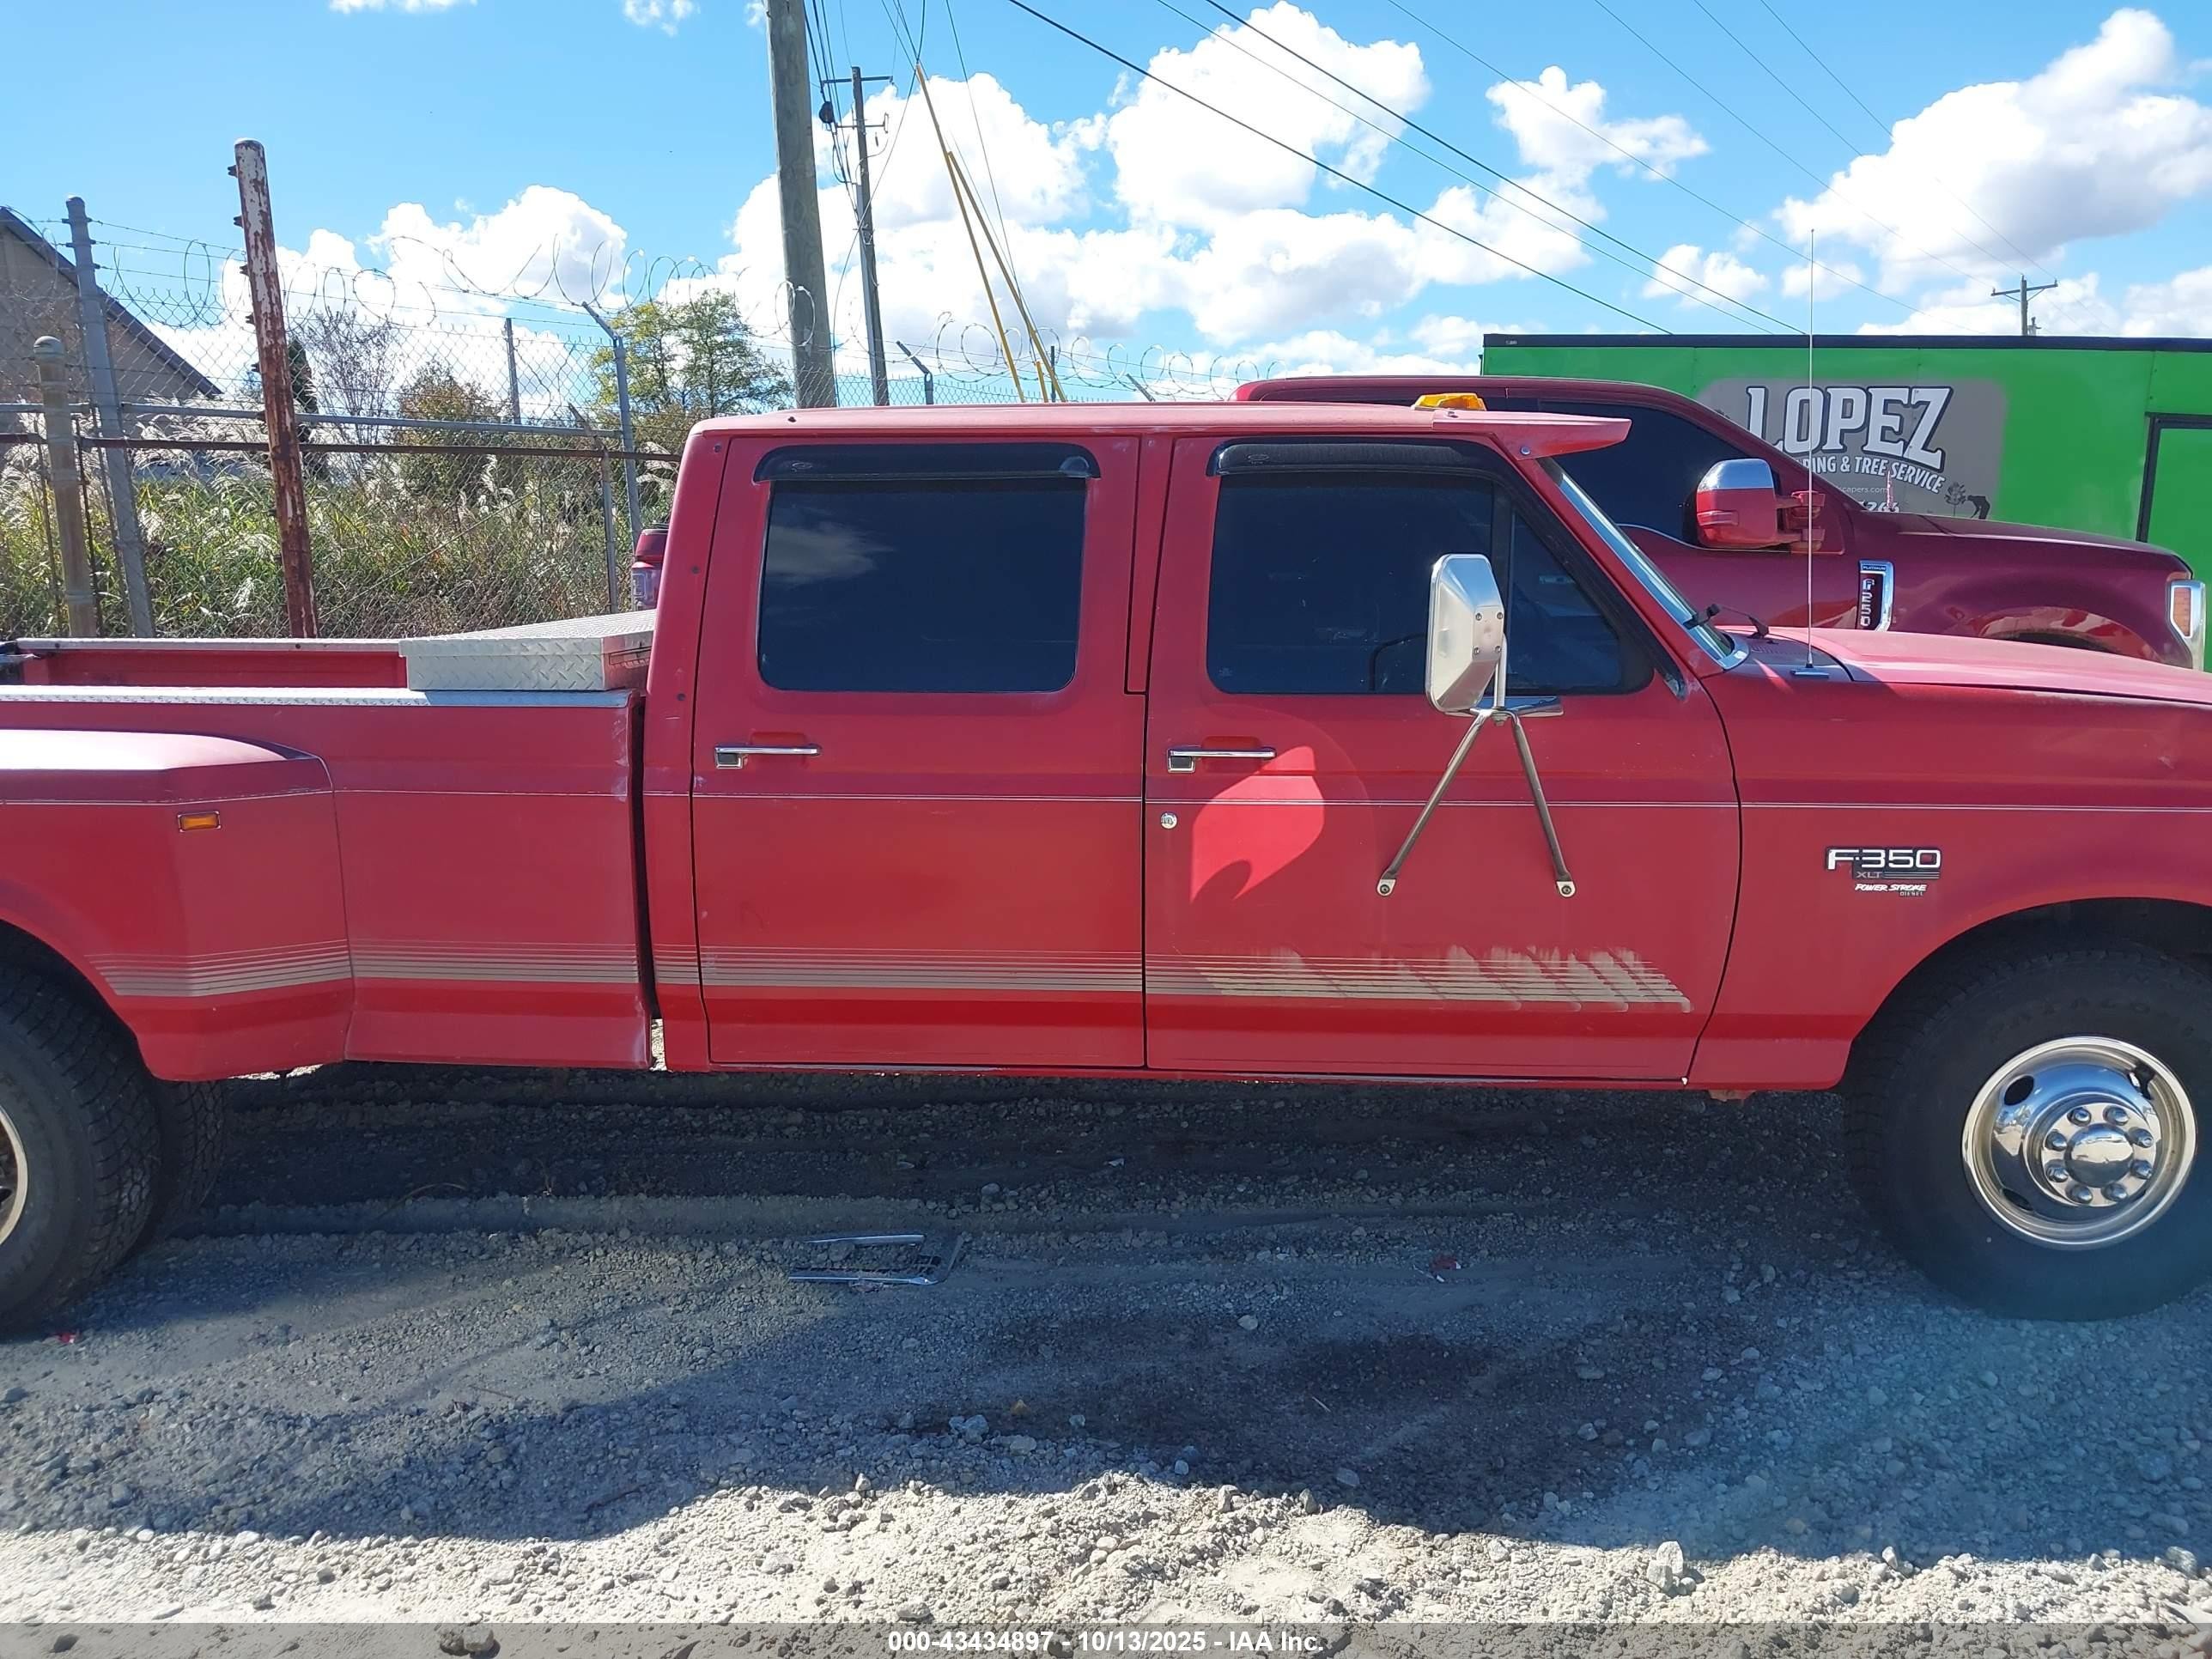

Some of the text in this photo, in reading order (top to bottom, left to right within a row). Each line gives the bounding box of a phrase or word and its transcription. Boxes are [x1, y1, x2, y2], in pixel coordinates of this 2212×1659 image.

[1747, 387, 1951, 470] LOPEZ
[1839, 455, 1851, 473] &
[1854, 456, 1889, 477] TREE
[1889, 461, 1947, 495] SERVICE
[1854, 883, 1888, 891] POWER
